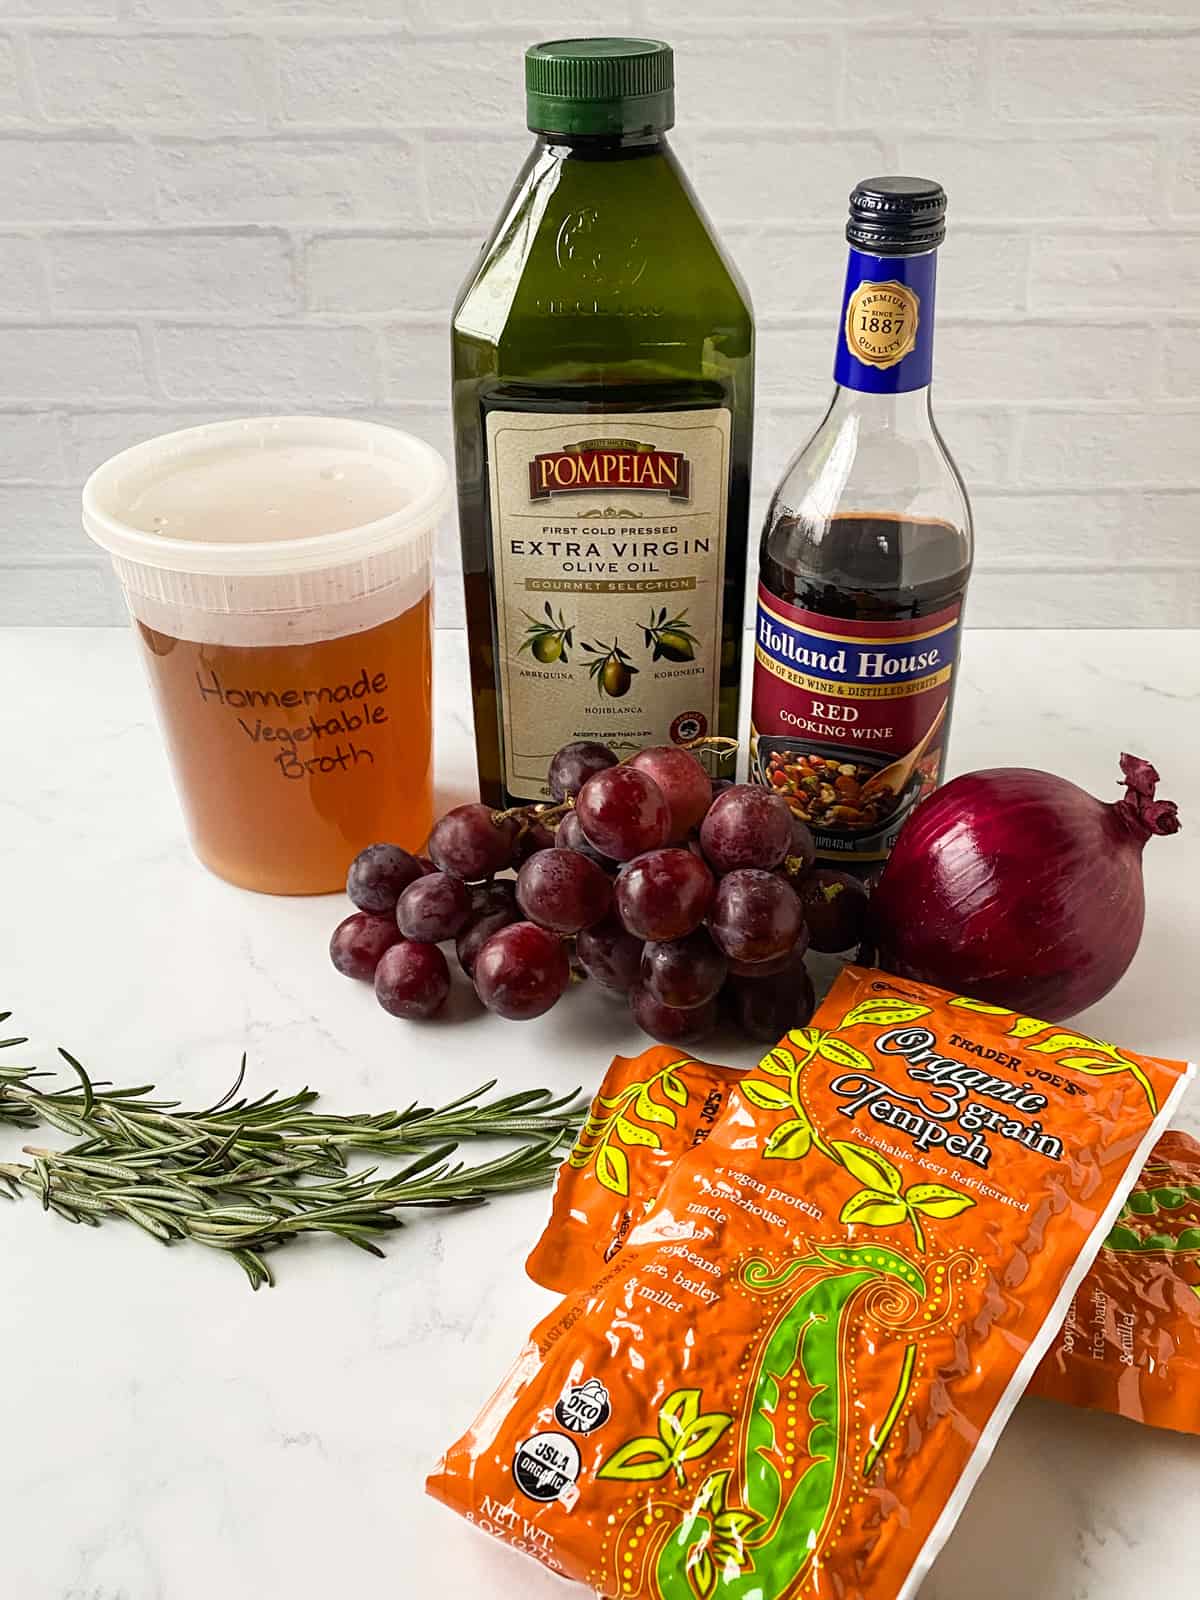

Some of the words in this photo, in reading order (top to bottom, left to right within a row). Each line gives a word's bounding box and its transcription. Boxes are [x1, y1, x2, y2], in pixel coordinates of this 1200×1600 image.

[862, 294, 906, 311] PREMIUM
[861, 316, 904, 335] 1887
[859, 336, 900, 353] QUALITY
[540, 454, 678, 488] POMPEIAN
[542, 526, 577, 535] FIRST
[582, 527, 616, 535] COLD
[621, 526, 678, 535] PRESSED
[511, 540, 601, 557] EXTRA
[612, 538, 710, 557] VIRGIN
[562, 562, 618, 573] OLIVE
[627, 562, 660, 572] OIL
[532, 581, 600, 591] GOURMET
[608, 580, 690, 591] SELECTION
[760, 616, 847, 674] Holland
[856, 648, 941, 678] House
[196, 669, 388, 708] Homemade
[775, 667, 786, 677] OF
[787, 672, 804, 685] RED
[807, 679, 833, 693] WINE
[837, 686, 844, 695] &
[848, 687, 904, 697] DISTILLED
[237, 703, 389, 750] Vegetable
[585, 706, 643, 715] HOJIBLANCA
[779, 710, 846, 738] COOKING
[852, 728, 893, 739] WINE
[810, 700, 859, 722] RED
[274, 743, 374, 779] Broth
[875, 1027, 1048, 1114] Organic
[949, 1034, 1022, 1073] TRADER
[1025, 1068, 1082, 1096] JOE'S
[830, 1074, 993, 1170] Tempeh
[960, 1103, 1064, 1161] grain
[851, 1127, 915, 1163] Perishable,
[917, 1157, 948, 1176] Keep
[950, 1170, 1030, 1213] Refrigerated
[728, 1168, 766, 1194] vegan
[767, 1188, 824, 1221] protein
[686, 1203, 727, 1224] made
[624, 1277, 639, 1292] &
[638, 1286, 684, 1313] millet
[673, 1270, 721, 1304] barley
[1088, 1328, 1106, 1360] rice,
[567, 1395, 599, 1419] OTCO
[480, 1495, 520, 1530] NET
[523, 1519, 555, 1553] WT.
